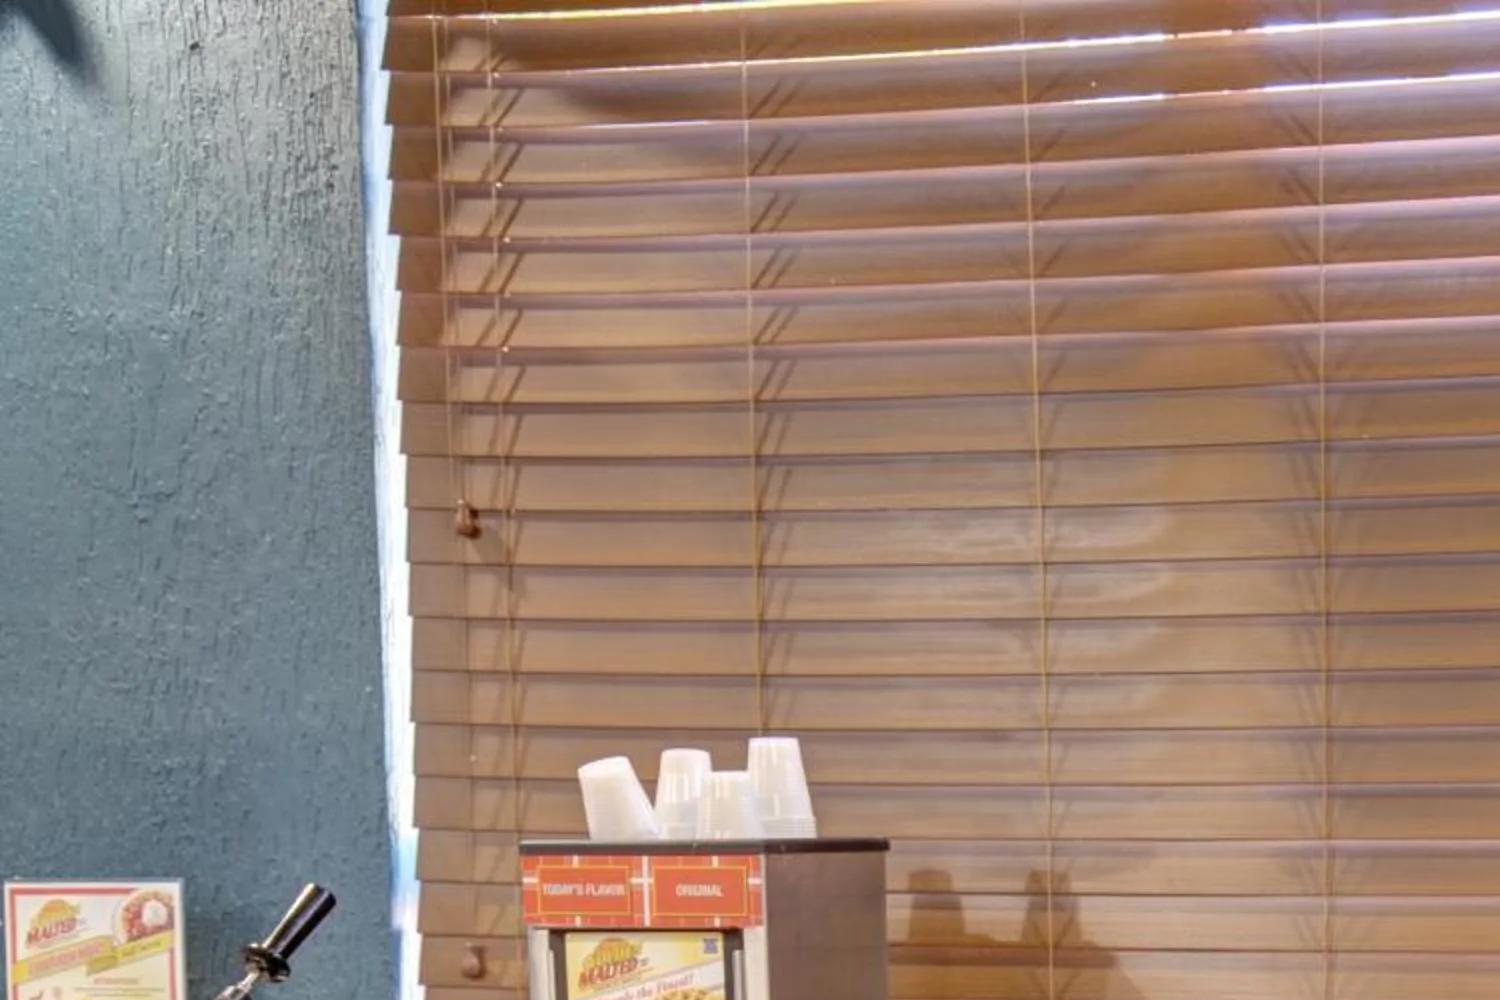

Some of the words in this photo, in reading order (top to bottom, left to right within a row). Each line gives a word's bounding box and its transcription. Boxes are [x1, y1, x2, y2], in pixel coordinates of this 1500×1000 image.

[585, 884, 625, 897] FLAVOR
[676, 884, 725, 897] ORIGINAL
[578, 957, 638, 988] MALTED
